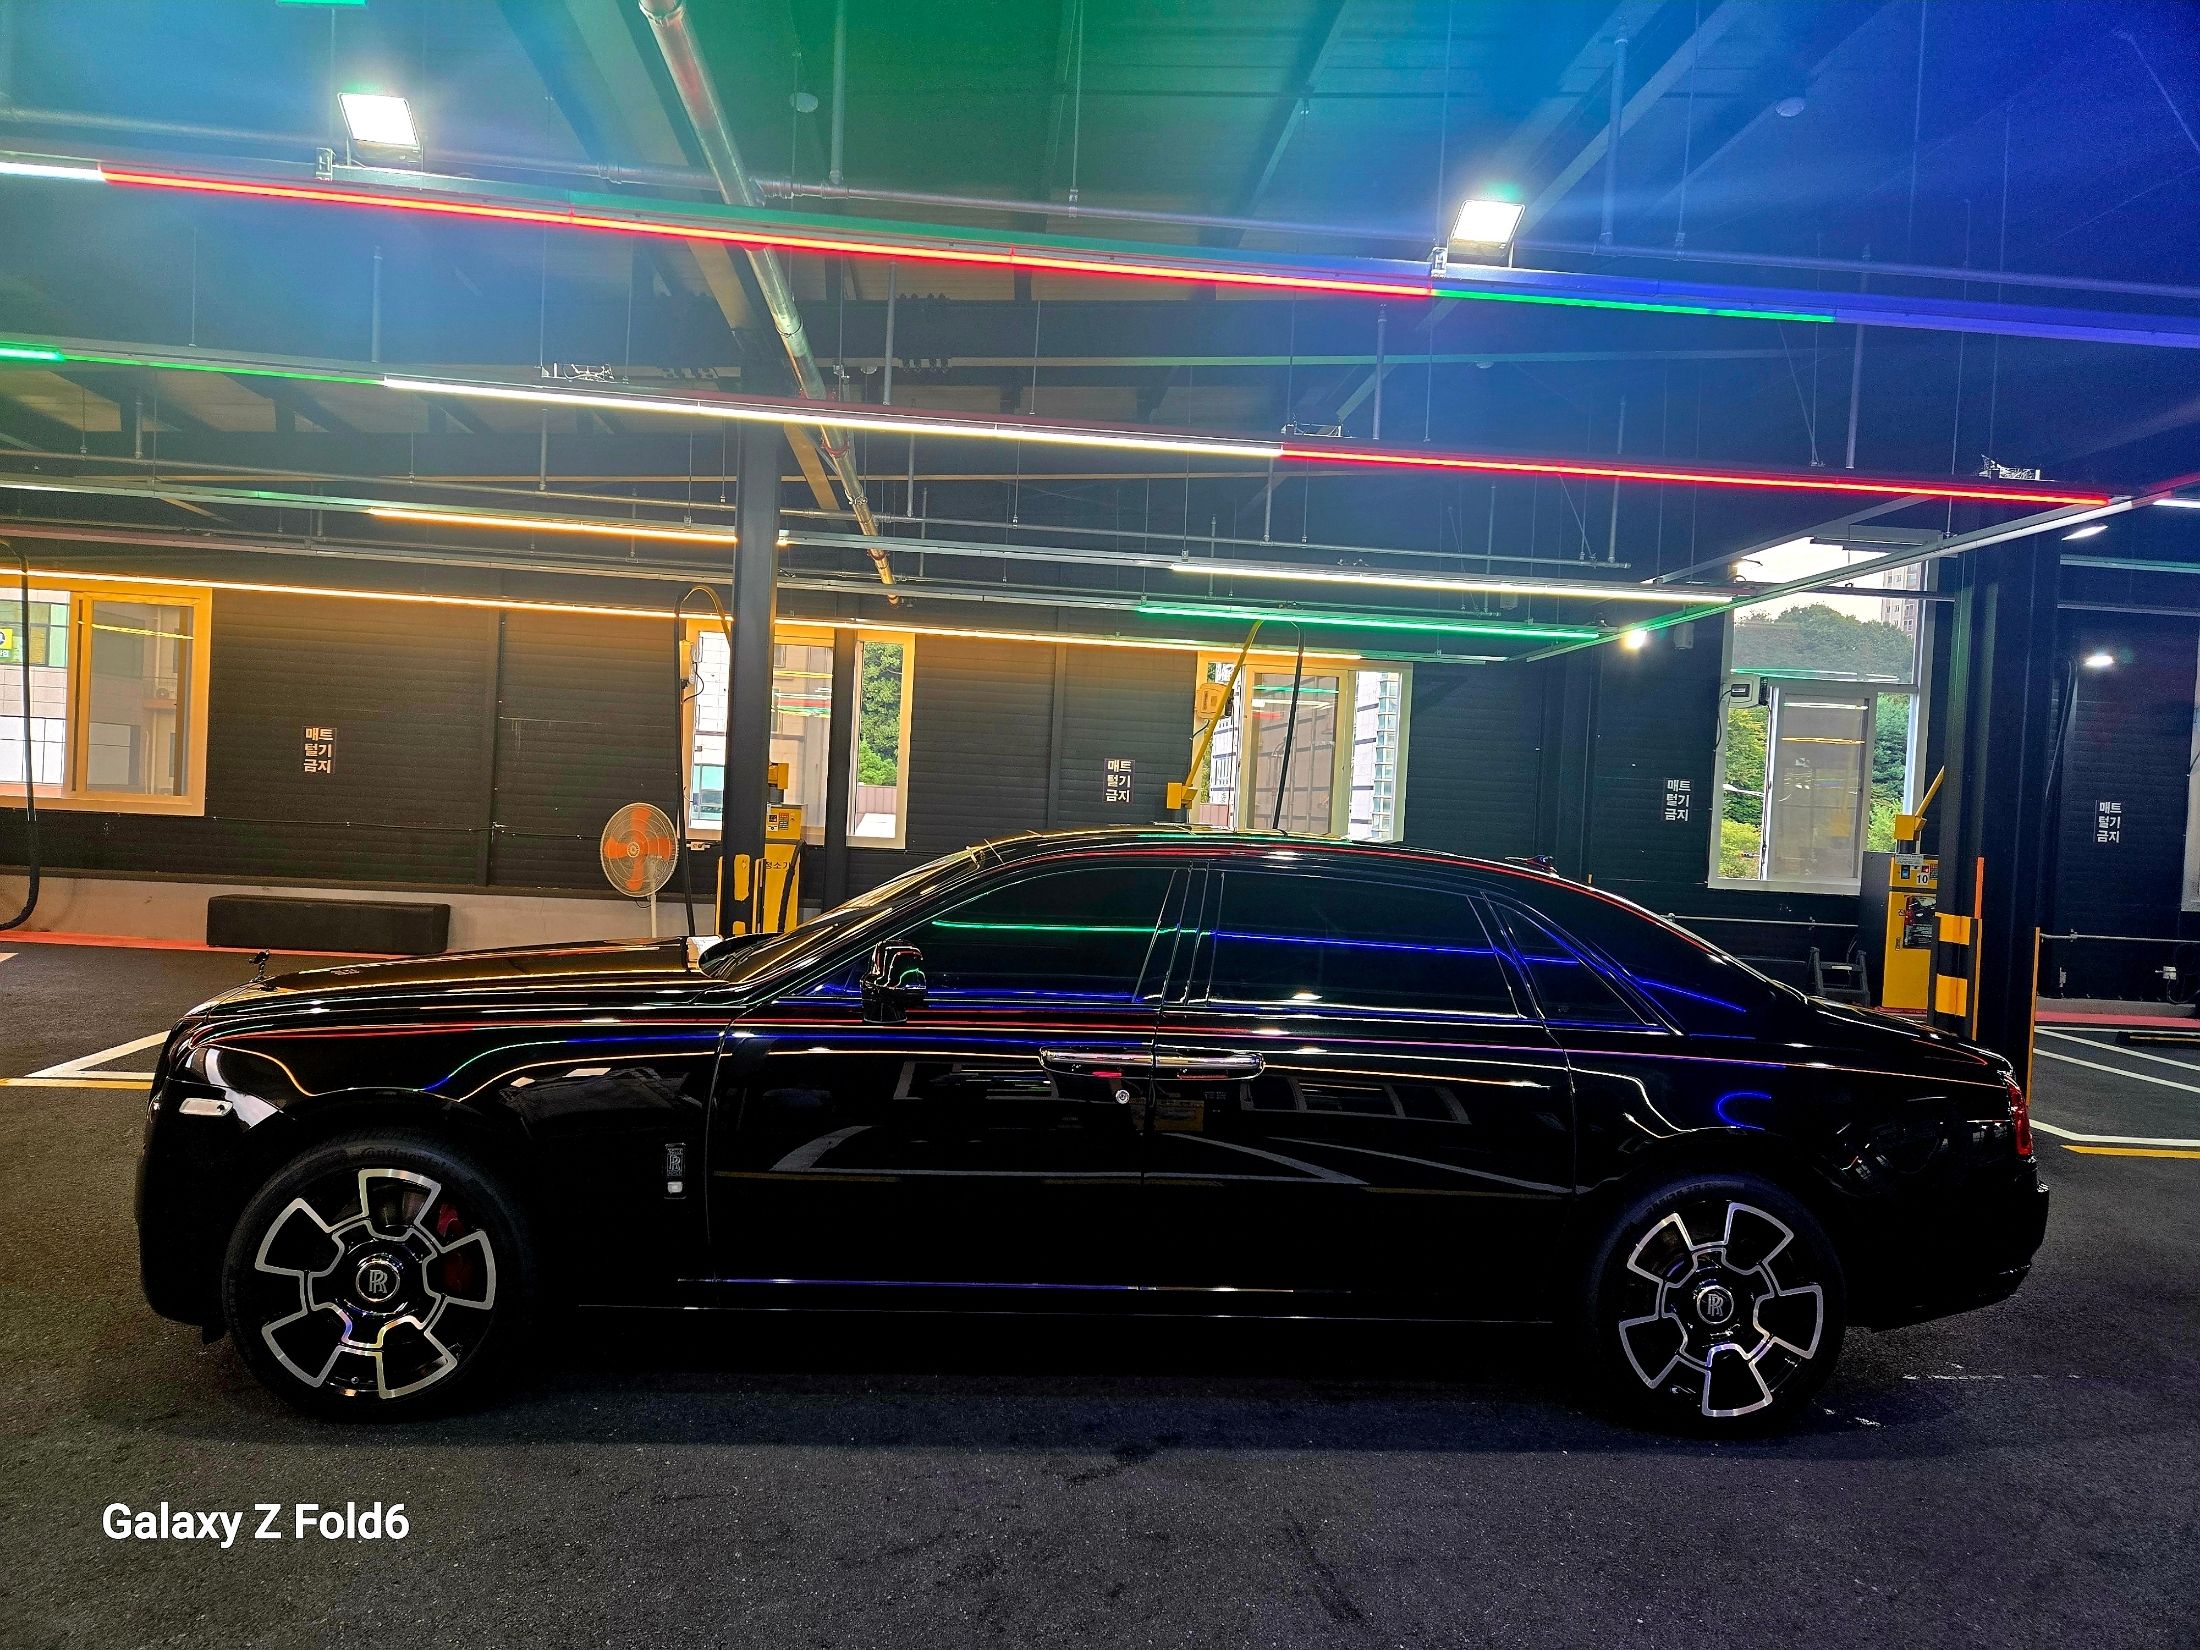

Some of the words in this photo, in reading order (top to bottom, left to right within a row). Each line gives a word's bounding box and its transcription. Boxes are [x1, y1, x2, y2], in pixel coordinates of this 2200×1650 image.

[305, 727, 334, 741] 매트
[304, 743, 332, 758] 털기
[303, 758, 331, 773] 금지
[1107, 759, 1132, 773] 매트
[1106, 774, 1131, 788] 털기
[1667, 779, 1691, 792] 매트
[1105, 788, 1130, 803] 금지
[1666, 793, 1690, 807] 털기
[2099, 801, 2122, 814] 매트
[1664, 808, 1689, 822] 금지
[2098, 815, 2121, 829] 털기
[2096, 829, 2120, 843] 금지
[1916, 874, 1929, 884] 10
